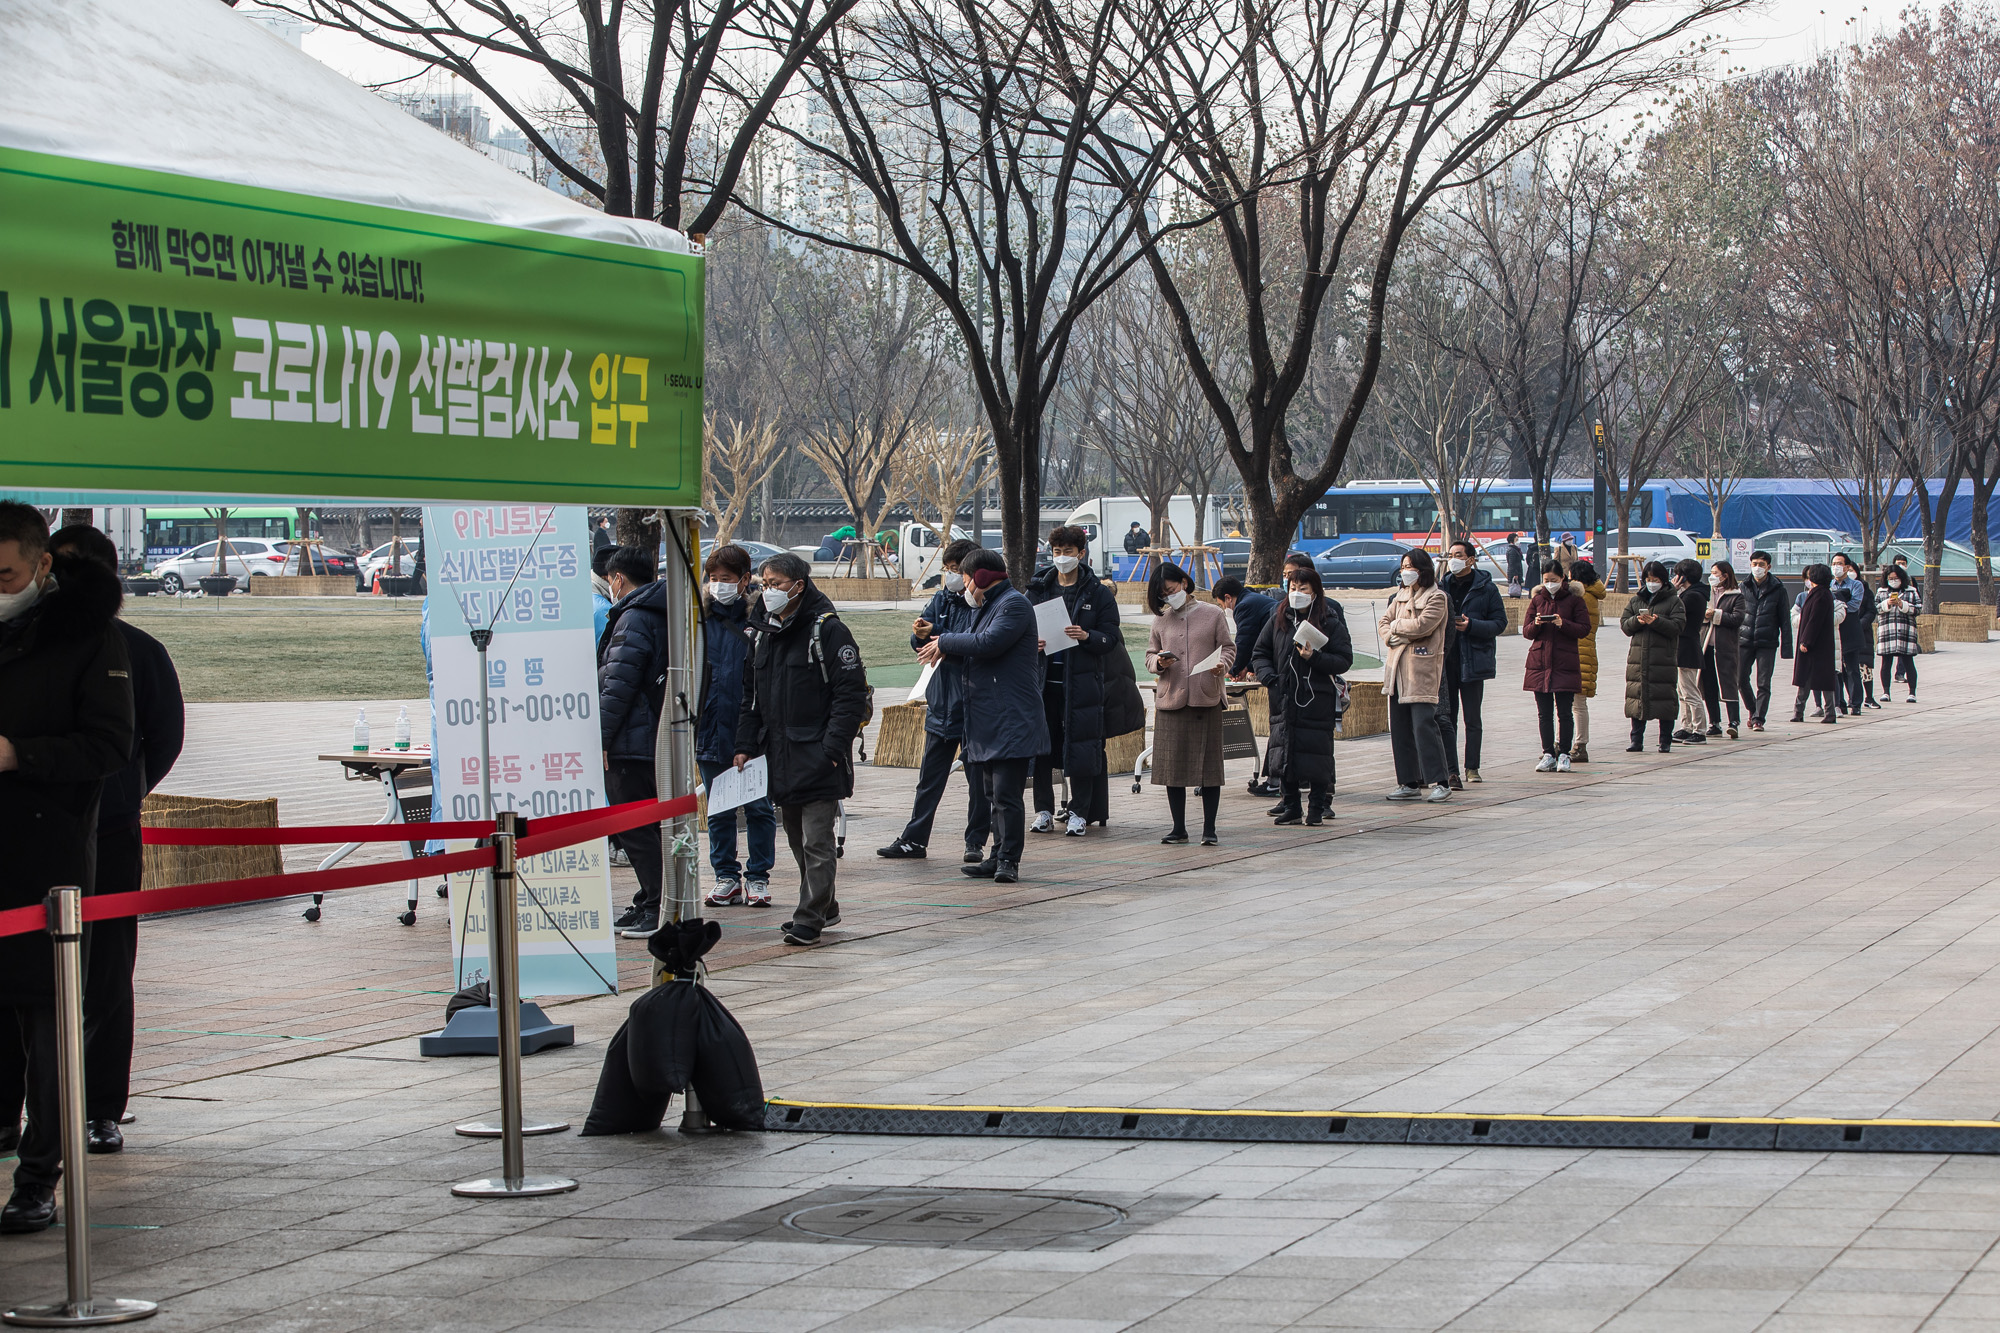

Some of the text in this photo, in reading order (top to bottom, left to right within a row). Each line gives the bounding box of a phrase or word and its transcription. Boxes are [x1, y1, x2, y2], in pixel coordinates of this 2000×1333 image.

[111, 219, 425, 304] 함께 막으면 이겨낼 수 있습니다!
[29, 297, 221, 421] 서울광장
[230, 316, 401, 430] 코로나19
[409, 334, 580, 441] 선별검사소
[589, 352, 649, 448] 입구
[1315, 502, 1328, 510] 148
